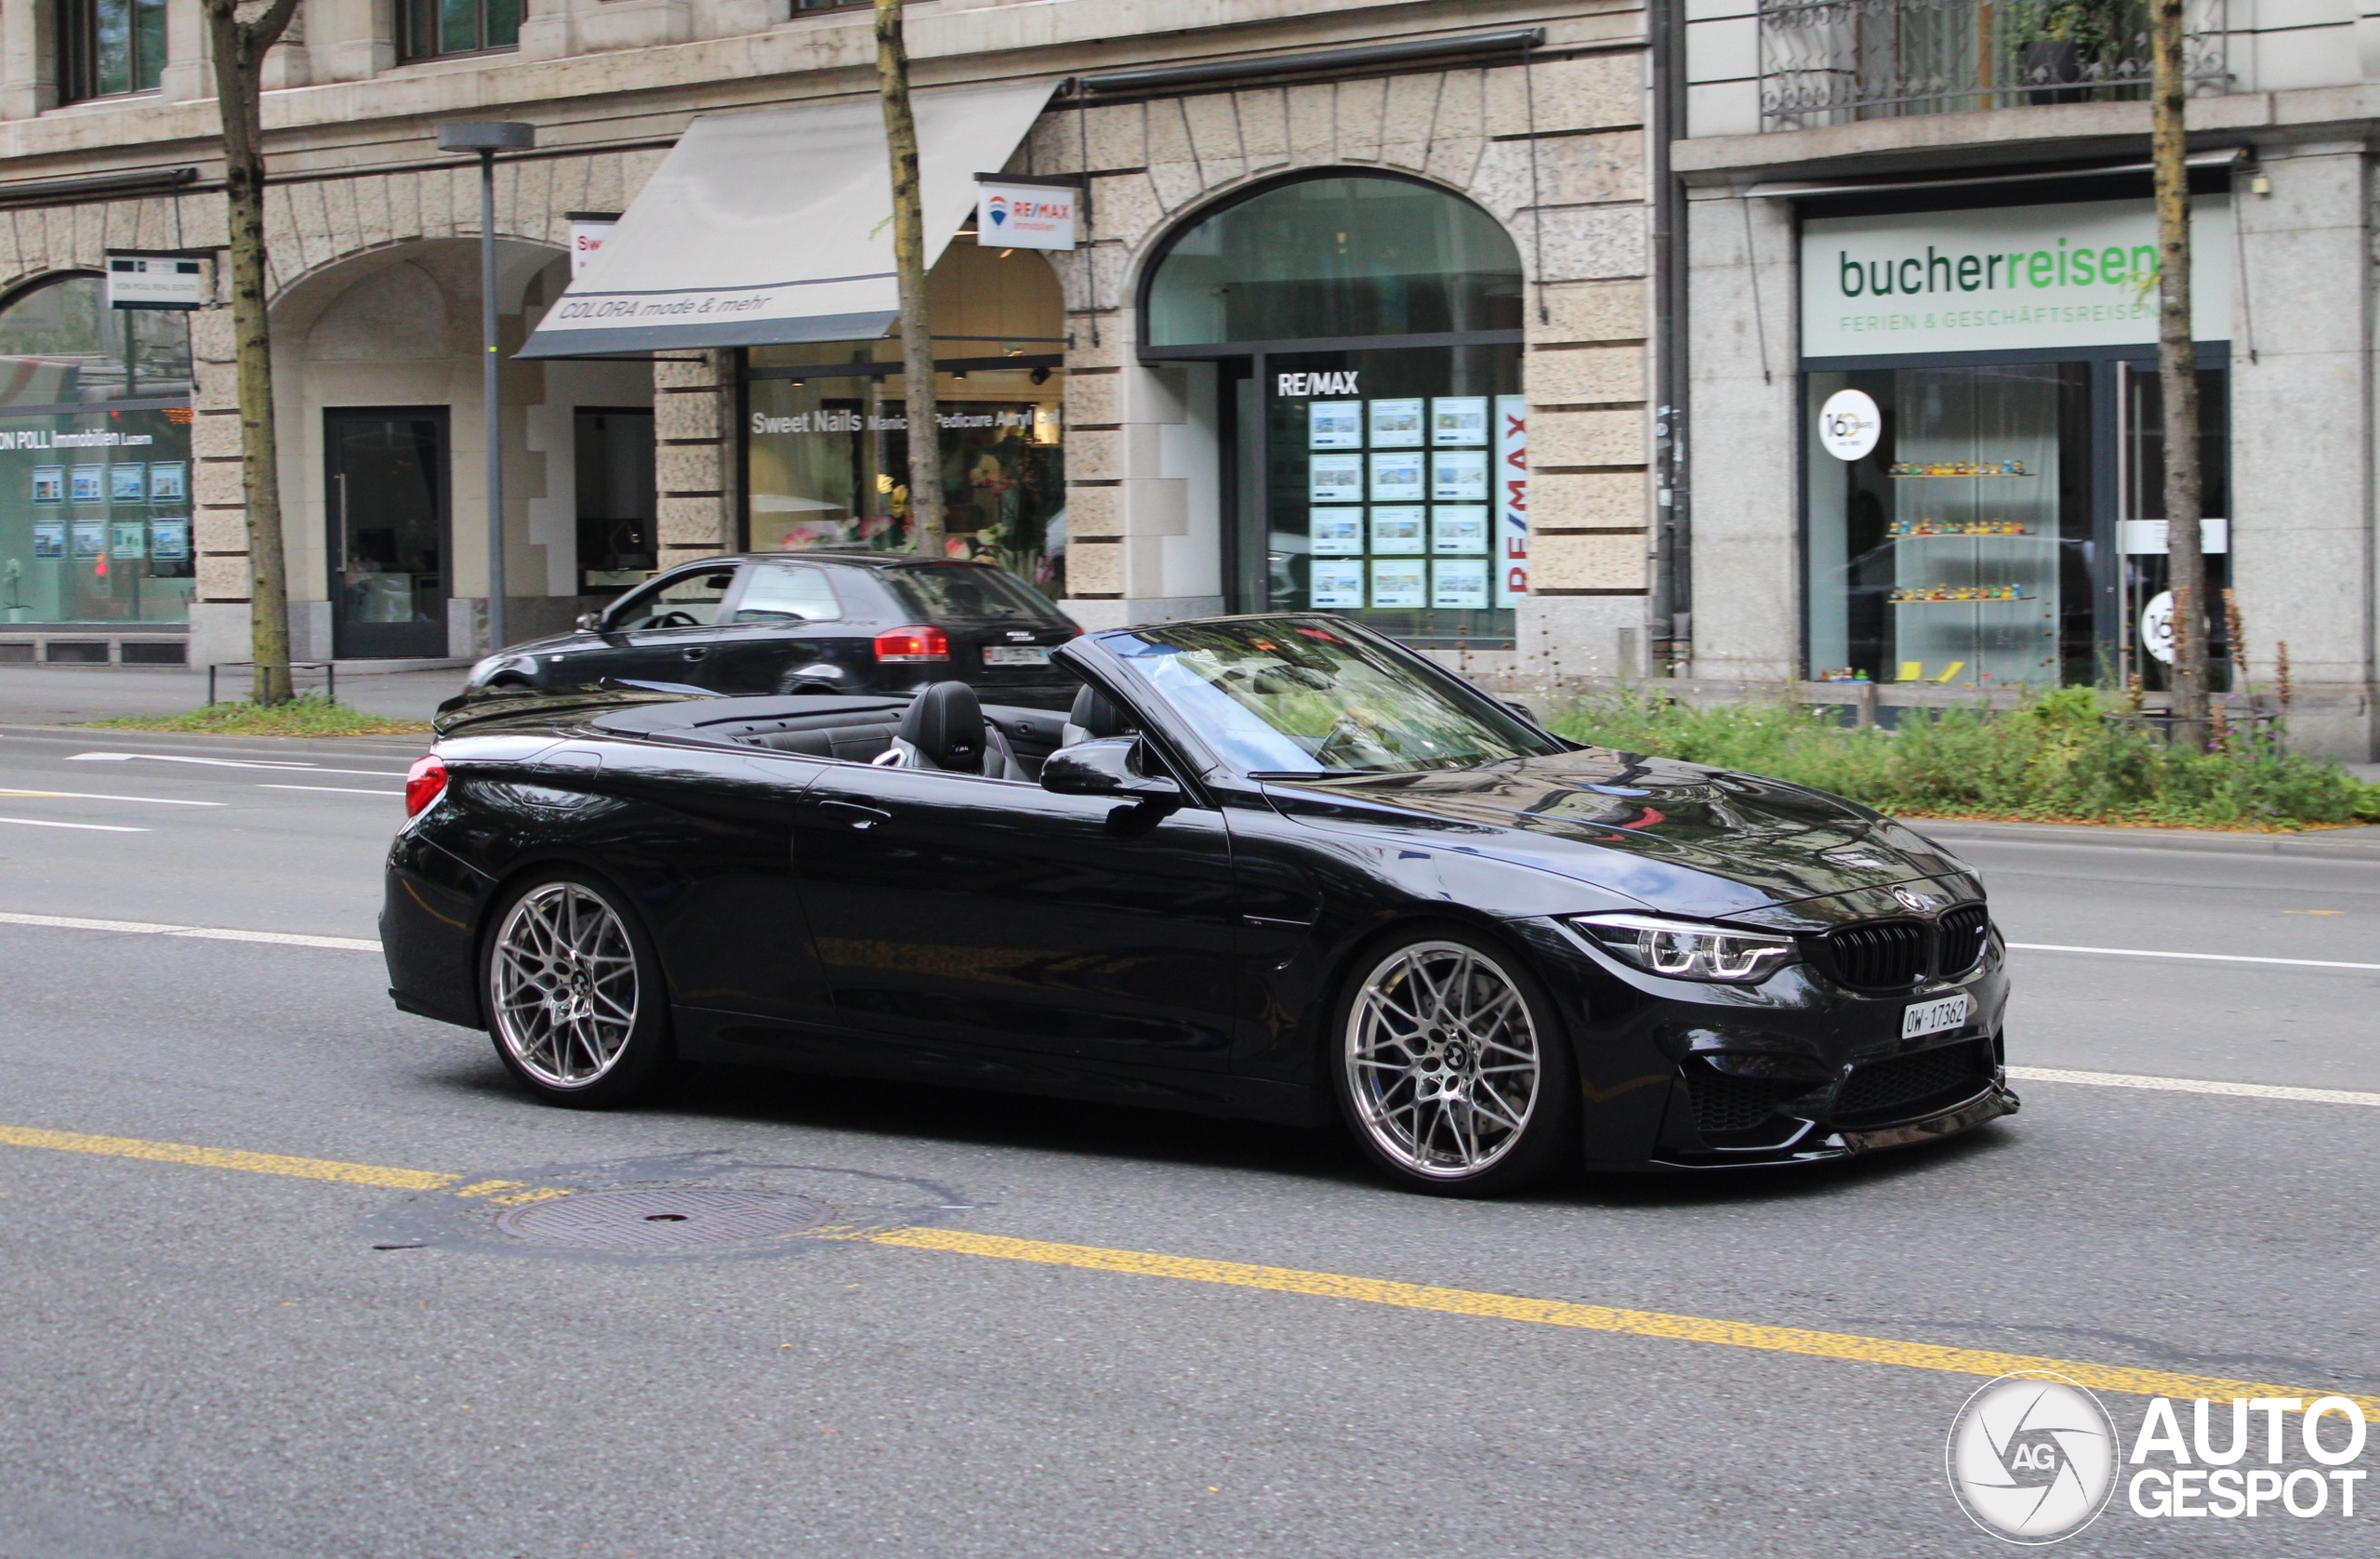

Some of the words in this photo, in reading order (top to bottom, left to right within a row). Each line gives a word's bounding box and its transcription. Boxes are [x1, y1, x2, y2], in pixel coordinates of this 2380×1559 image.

[1012, 201, 1070, 219] RE/MAX
[1840, 236, 2160, 297] bucherreisen
[559, 300, 640, 319] COLORA
[640, 297, 695, 316] mode
[698, 297, 716, 313] &
[717, 294, 773, 313] mehr
[1840, 313, 1917, 333] FERIEN
[1925, 313, 1937, 329] &
[1277, 371, 1359, 397] RE/MAX
[751, 412, 810, 434] Sweet
[813, 409, 863, 432] Nails
[17, 430, 50, 449] POLL
[51, 428, 120, 448] Immobilien
[121, 431, 153, 446] Luzern
